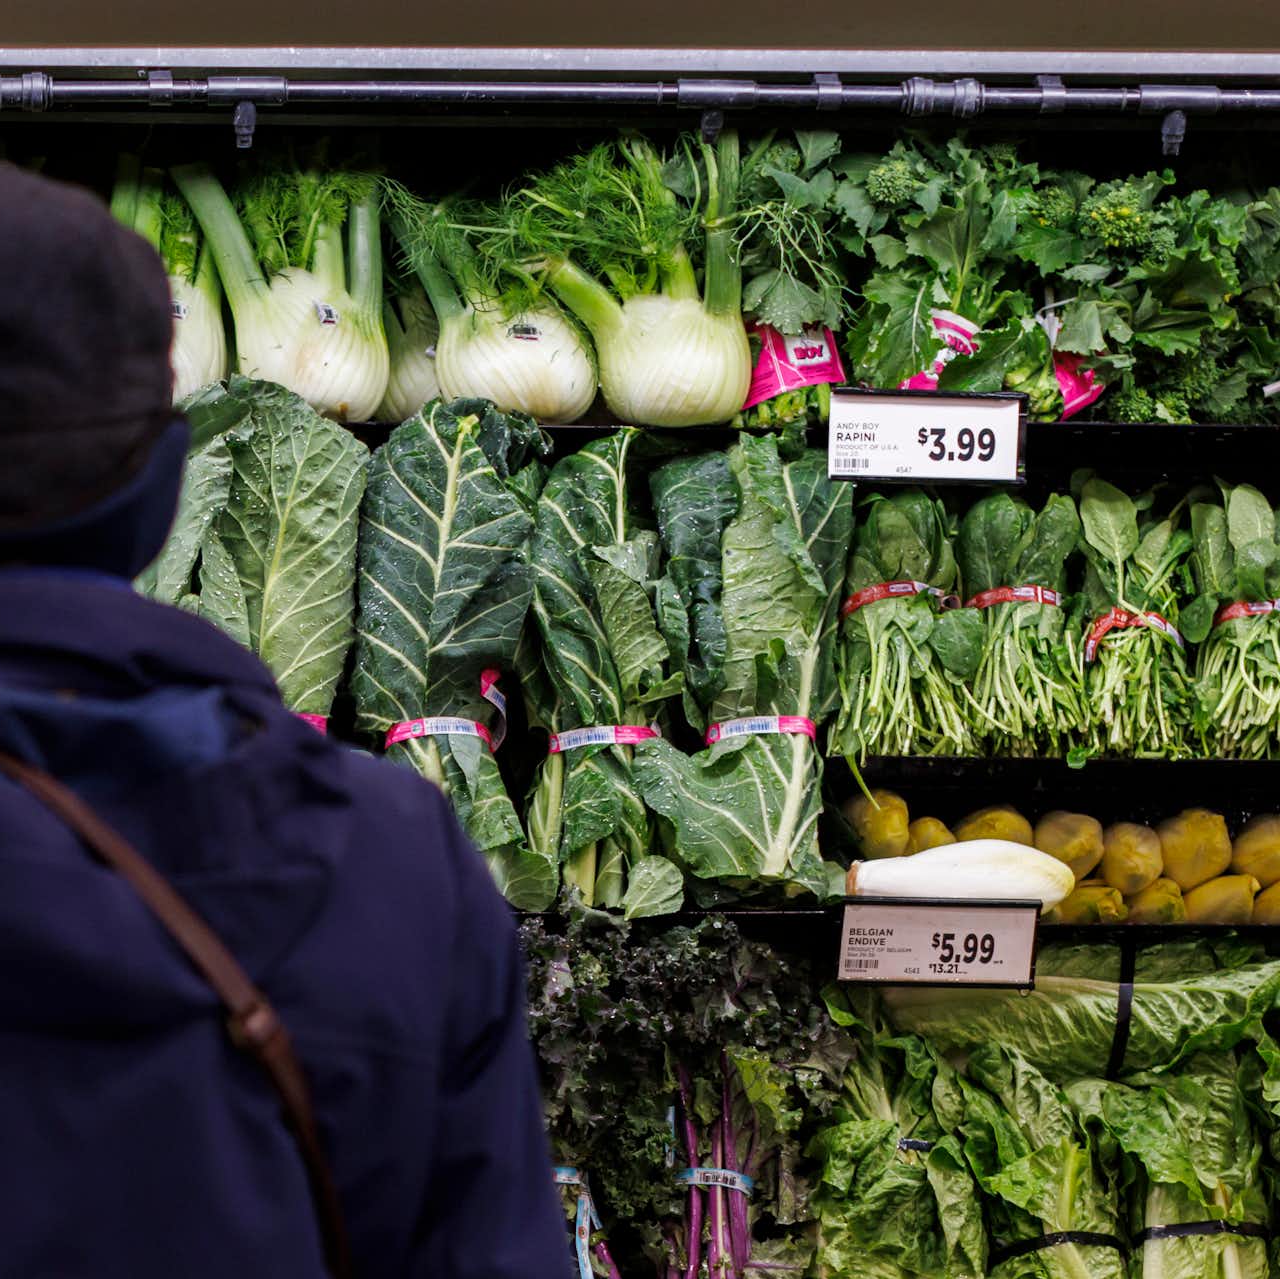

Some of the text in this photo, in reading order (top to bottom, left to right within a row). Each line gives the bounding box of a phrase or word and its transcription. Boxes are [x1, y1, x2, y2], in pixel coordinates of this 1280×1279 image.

[836, 422, 879, 430] ANDY BOY
[836, 432, 875, 442] RAPINI
[918, 426, 996, 462] $3.99
[849, 928, 894, 937] BELGIAN
[848, 937, 886, 946] ENDIVE
[931, 932, 995, 964] $5.99
[929, 963, 958, 974] $13.21
